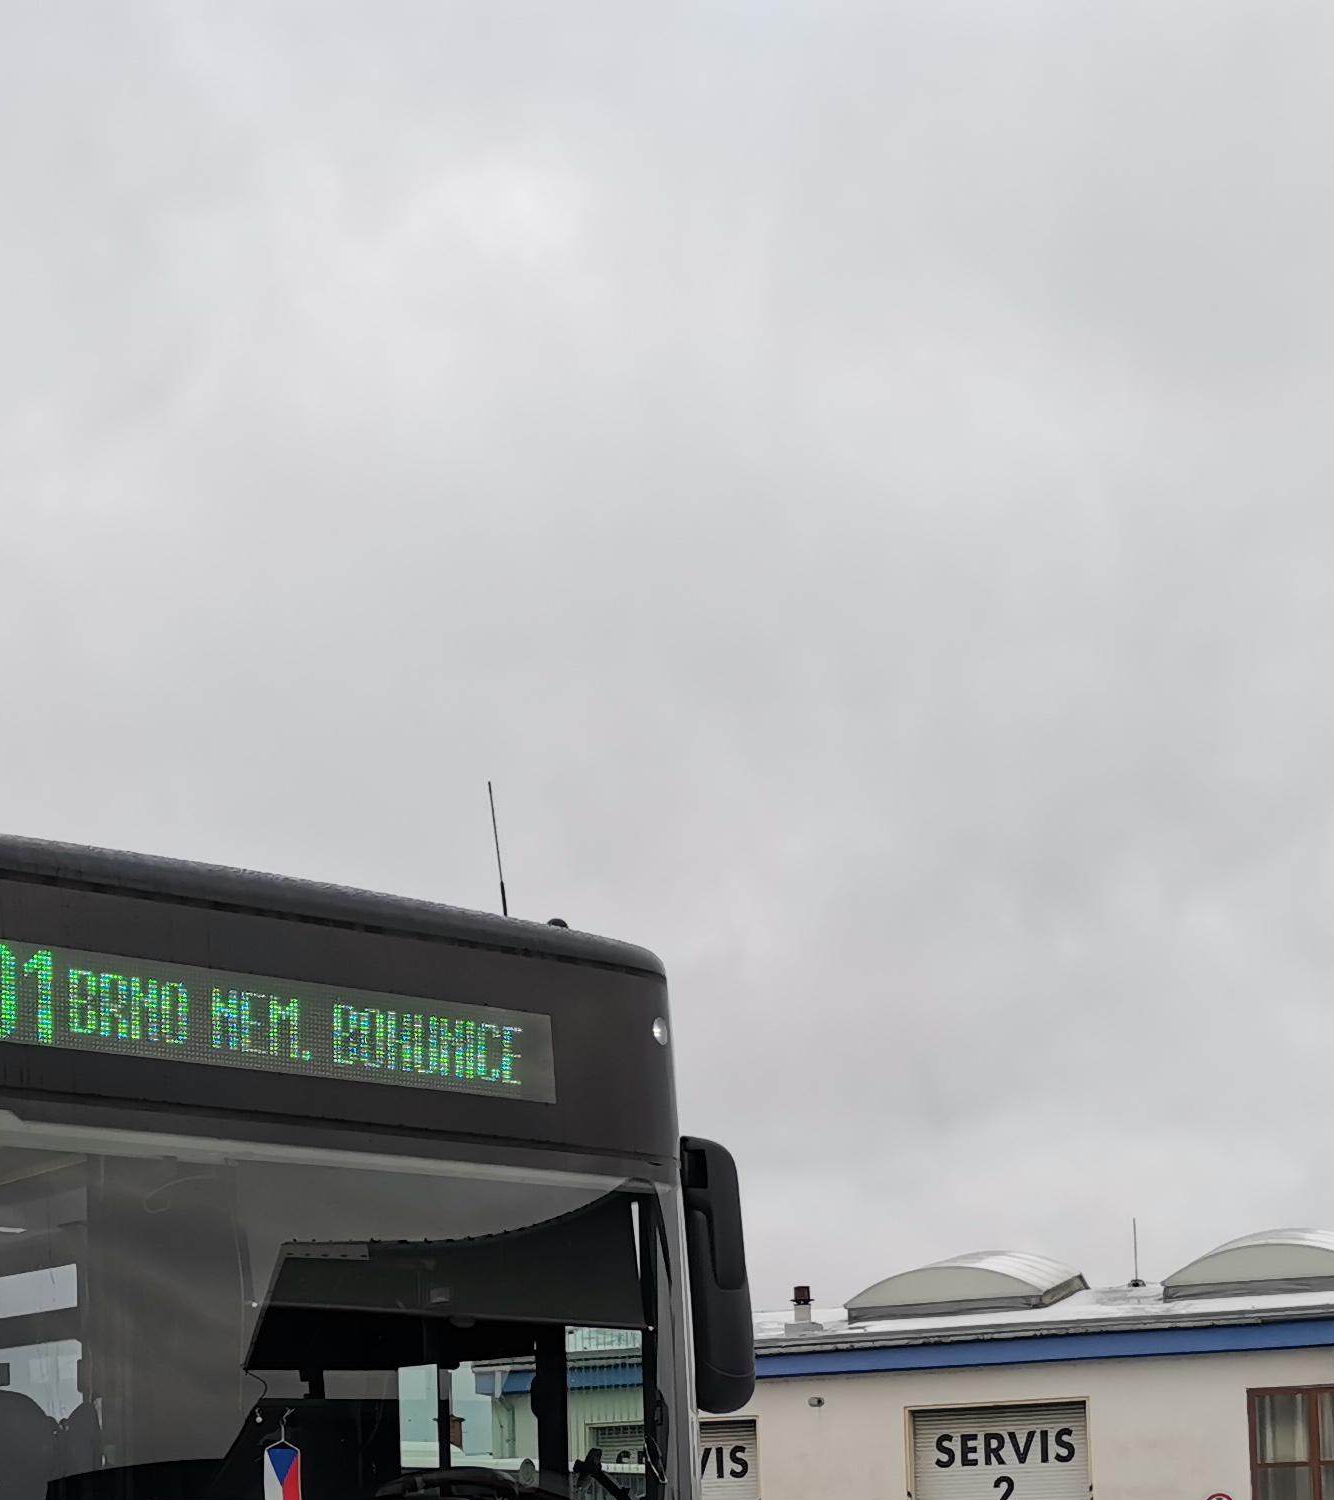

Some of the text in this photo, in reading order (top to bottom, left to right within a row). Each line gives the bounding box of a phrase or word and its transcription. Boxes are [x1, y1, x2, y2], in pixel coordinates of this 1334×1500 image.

[68, 968, 188, 1045] BRNO
[212, 986, 312, 1062] NEM.
[333, 1002, 522, 1085] BOHUNICE
[935, 1427, 1076, 1469] SERVIS
